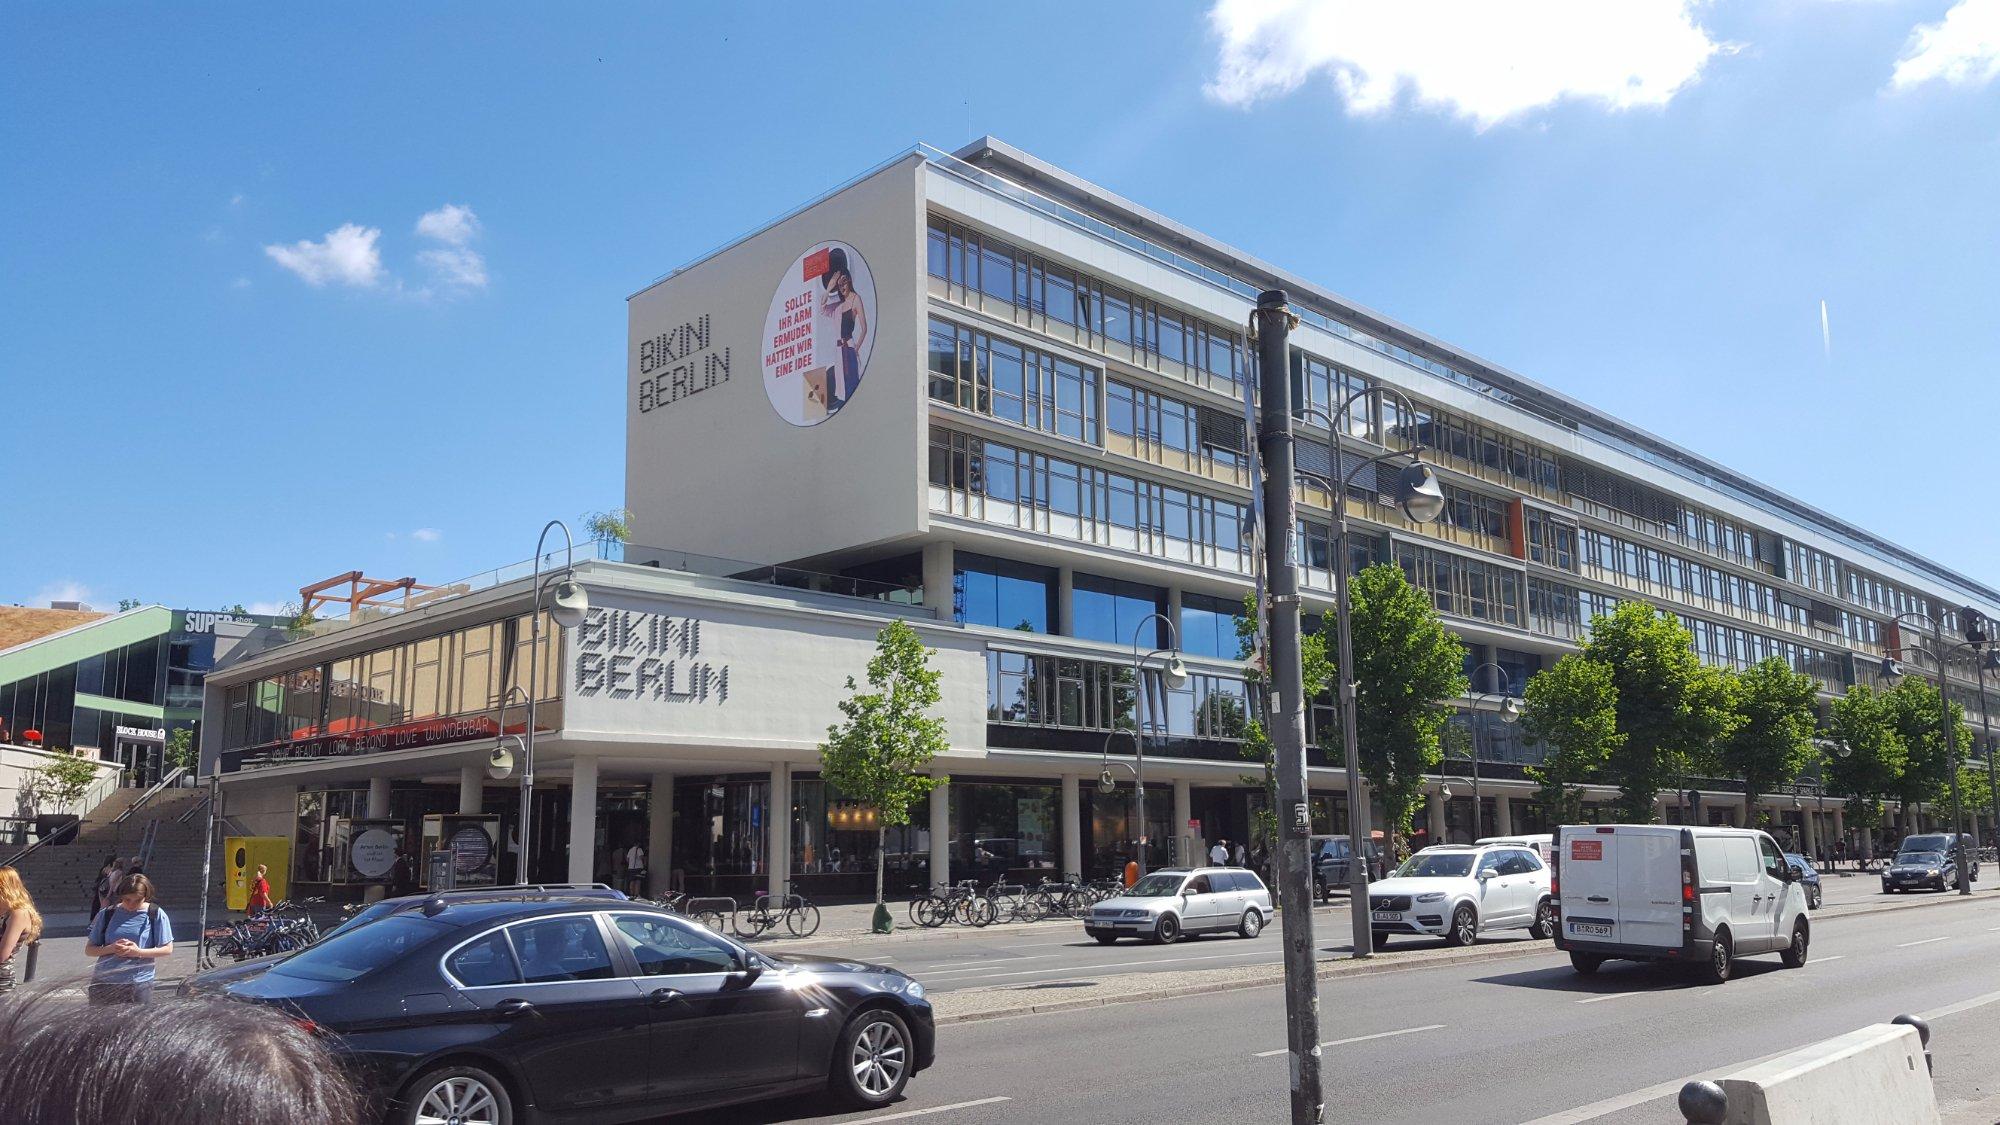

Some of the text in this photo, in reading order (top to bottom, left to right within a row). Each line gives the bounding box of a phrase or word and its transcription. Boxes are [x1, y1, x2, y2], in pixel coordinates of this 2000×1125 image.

[785, 290, 812, 314] SOLLTE
[779, 307, 812, 331] IHR ARM
[640, 313, 709, 374] BIKINI
[797, 337, 812, 353] WIR
[776, 353, 812, 379] EINE IDEE
[639, 346, 729, 414] BERLIN
[236, 616, 253, 624] shop
[577, 607, 700, 660] BIKINI
[575, 652, 729, 706] BERLIN
[116, 725, 157, 739] BLOCK HOUSE
[329, 739, 348, 755] LOOK
[355, 732, 388, 751] BEYOND
[395, 727, 418, 746] LOVE
[424, 717, 489, 741] WUNDERBAR
[1595, 926, 1608, 935] 569
